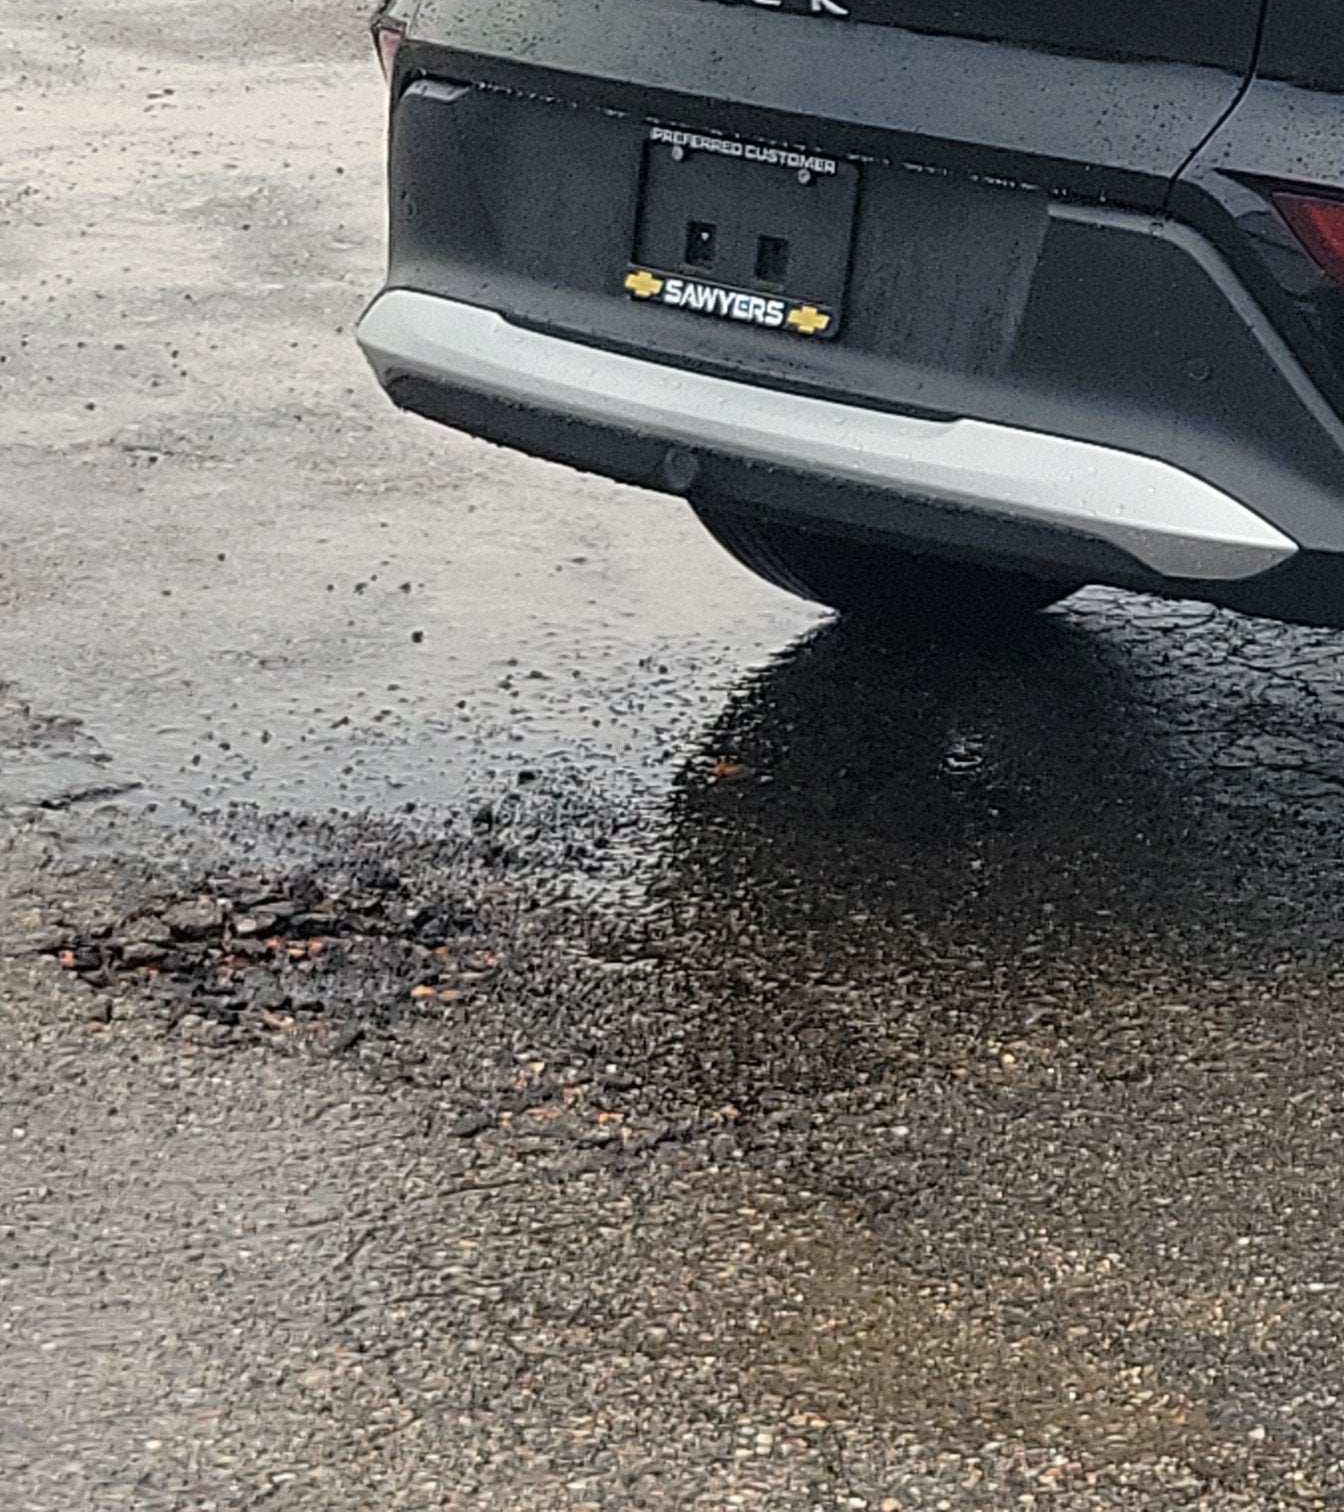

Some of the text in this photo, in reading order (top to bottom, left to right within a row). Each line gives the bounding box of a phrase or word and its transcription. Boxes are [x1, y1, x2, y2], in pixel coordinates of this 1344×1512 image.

[650, 126, 837, 175] PREFERRED CUSTOMER
[663, 278, 787, 328] SAWYERS
